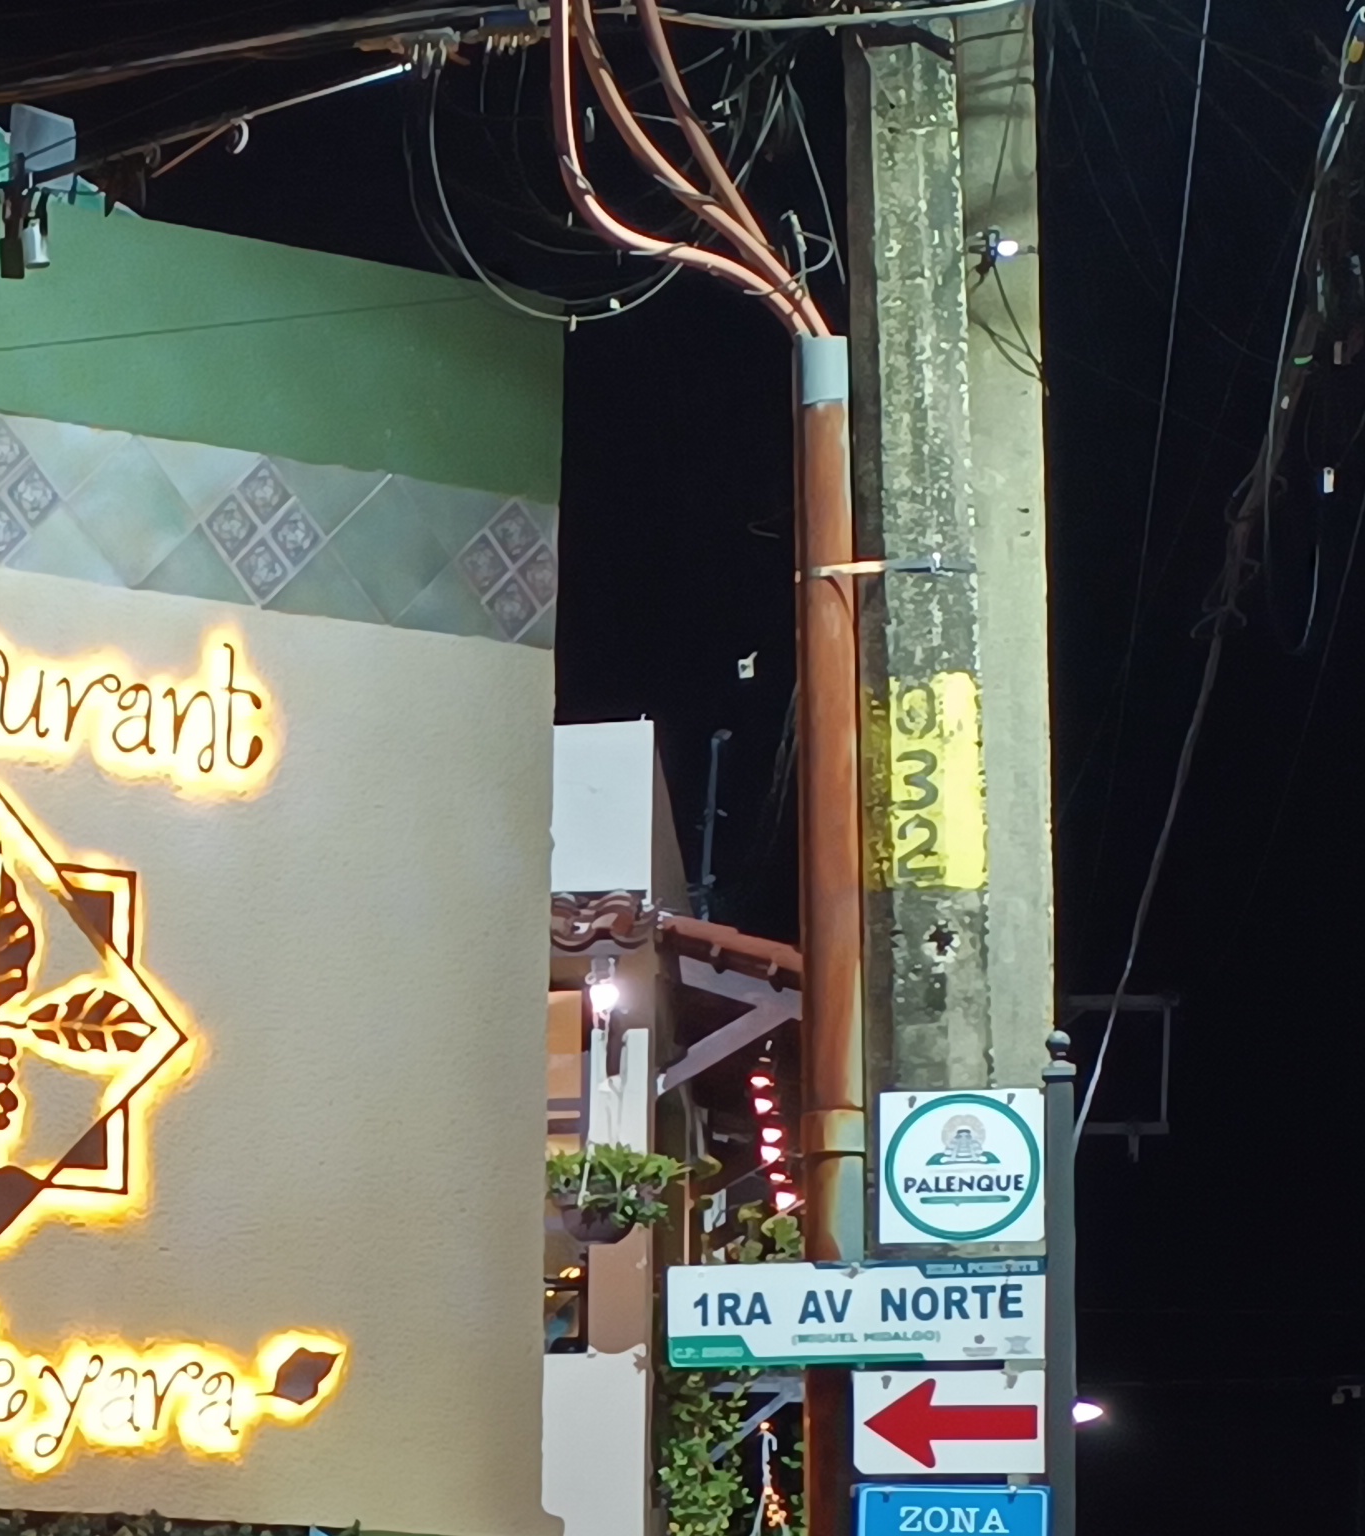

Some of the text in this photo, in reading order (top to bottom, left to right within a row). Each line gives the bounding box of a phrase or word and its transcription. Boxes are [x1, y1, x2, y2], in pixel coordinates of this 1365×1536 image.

[904, 1174, 1025, 1194] PALENQUE
[693, 1283, 1024, 1327] 1RA AV NORTE
[36, 1344, 240, 1459] yara
[899, 1506, 1010, 1534] ZONA
